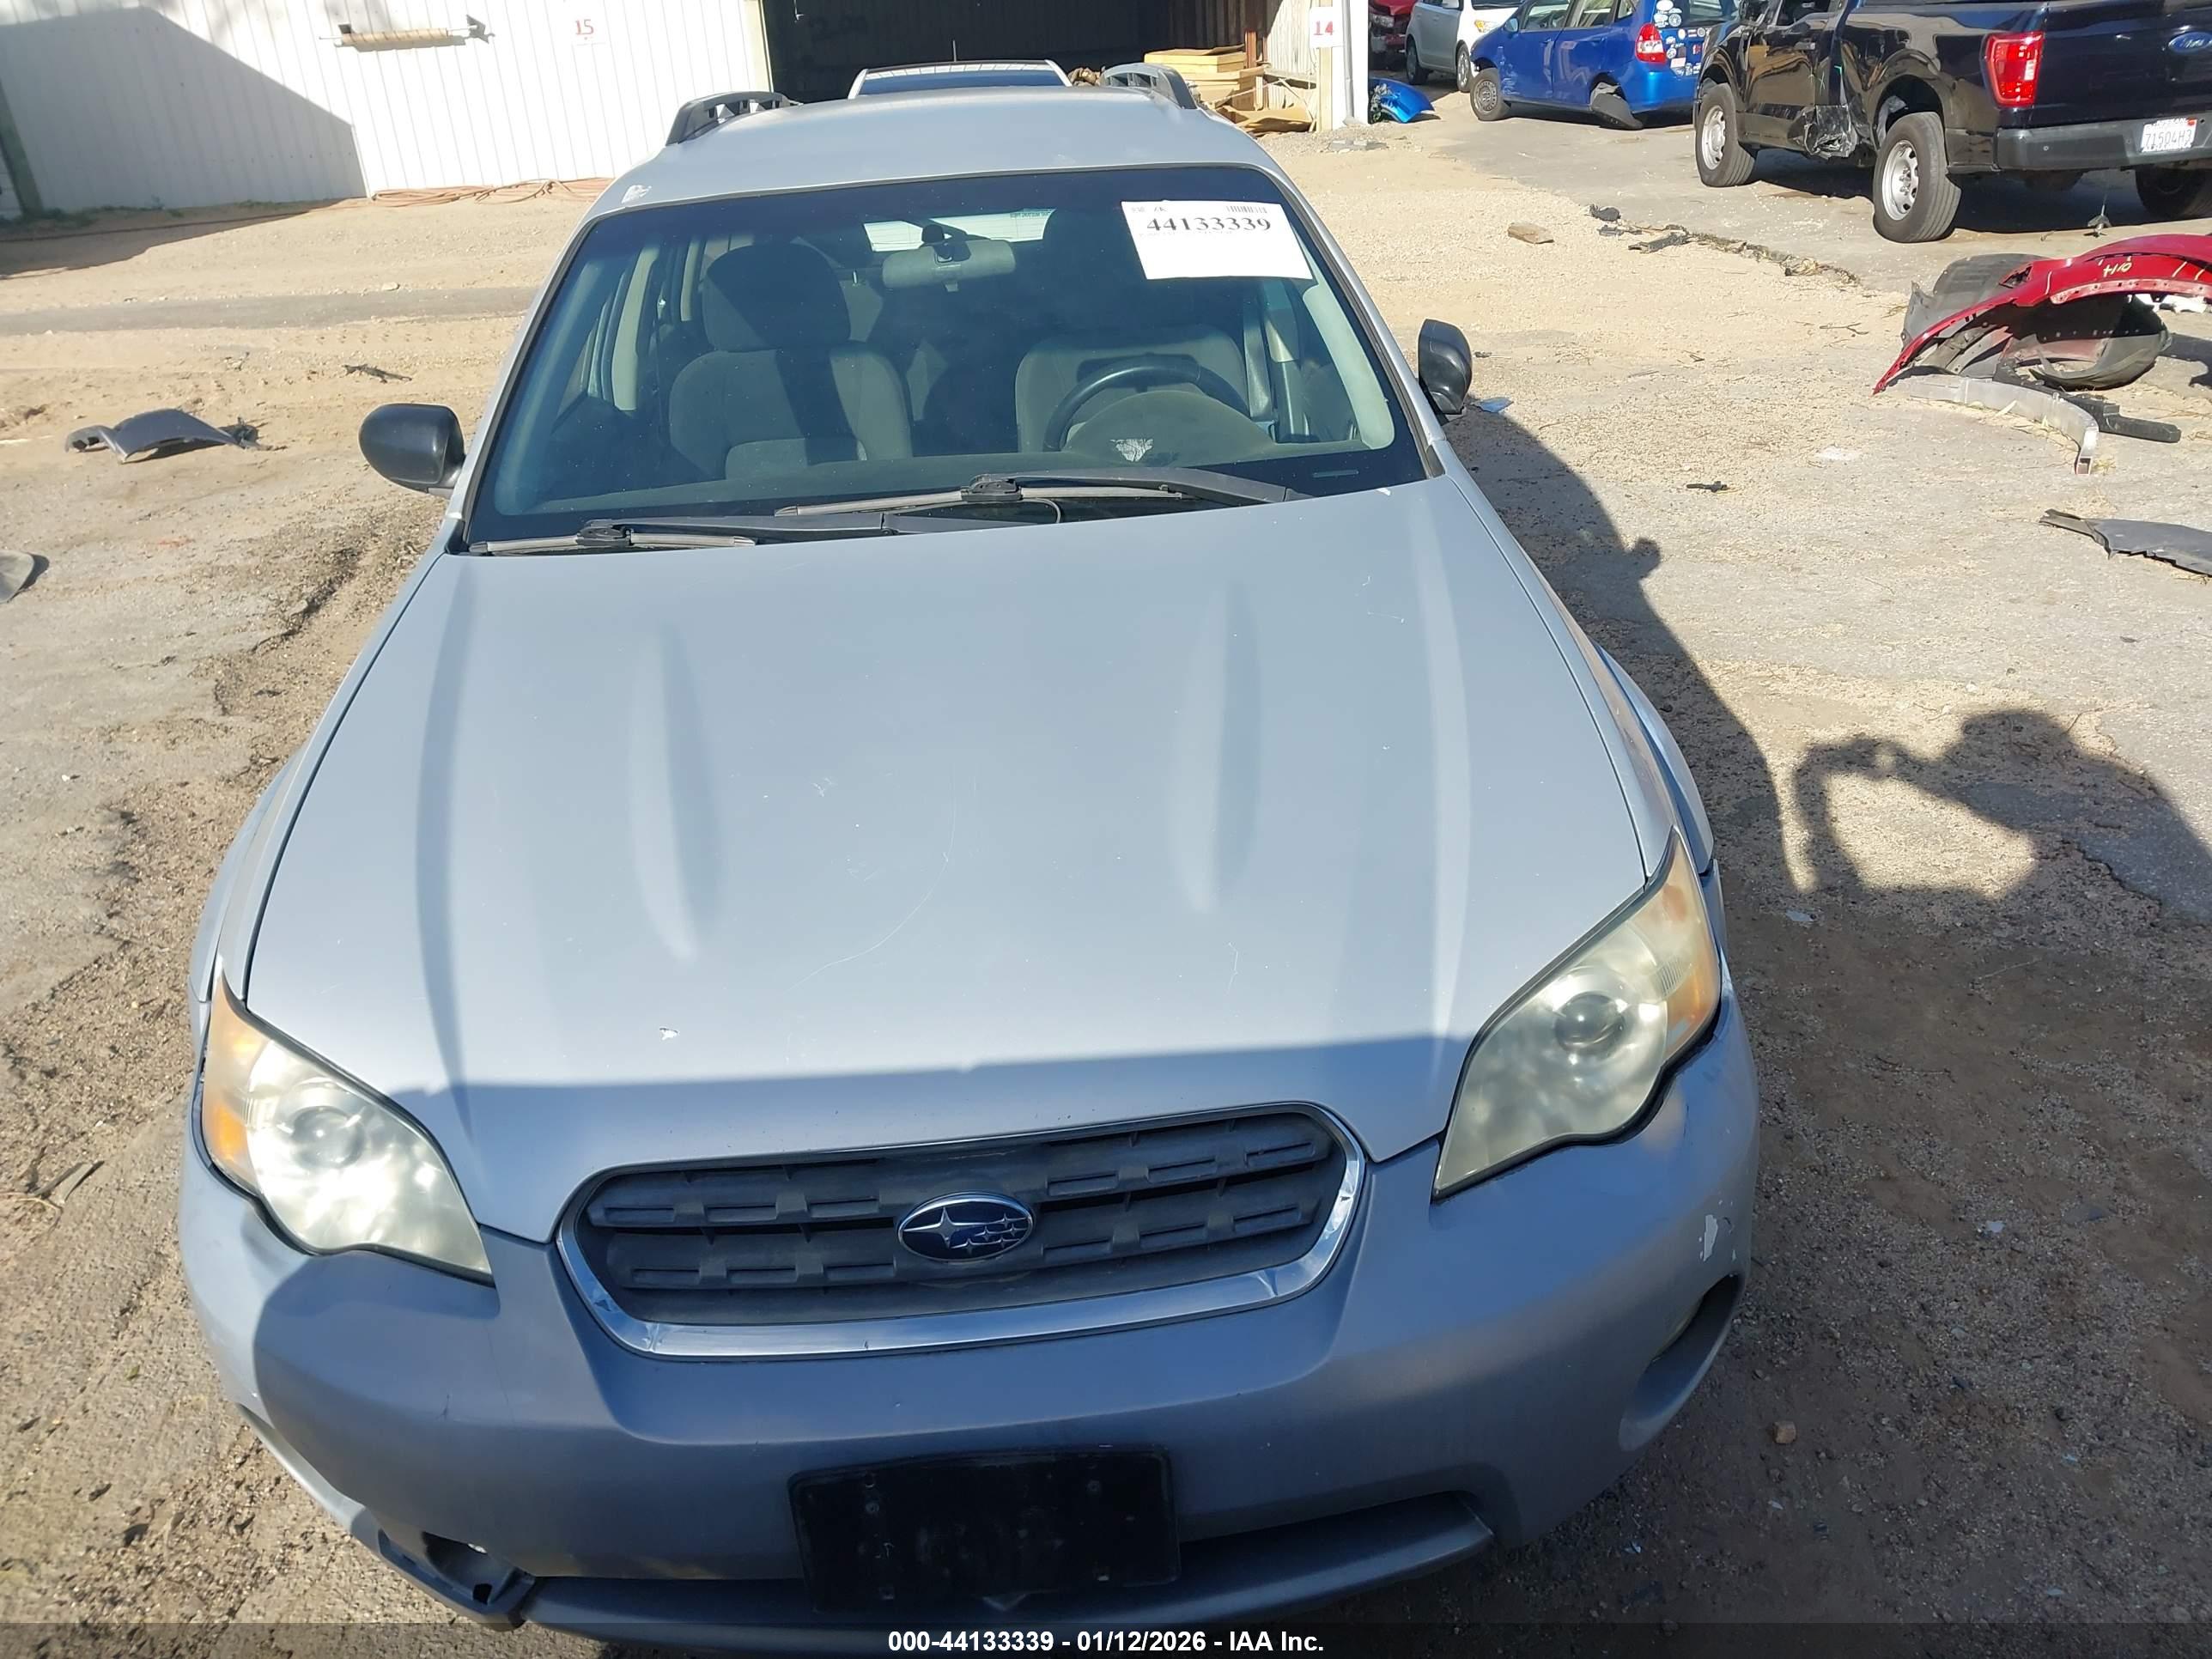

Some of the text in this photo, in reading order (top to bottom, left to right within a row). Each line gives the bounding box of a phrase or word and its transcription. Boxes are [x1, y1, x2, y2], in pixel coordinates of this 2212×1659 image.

[574, 19, 594, 35] 15
[1313, 20, 1334, 36] 14
[1146, 217, 1271, 231] 44133339
